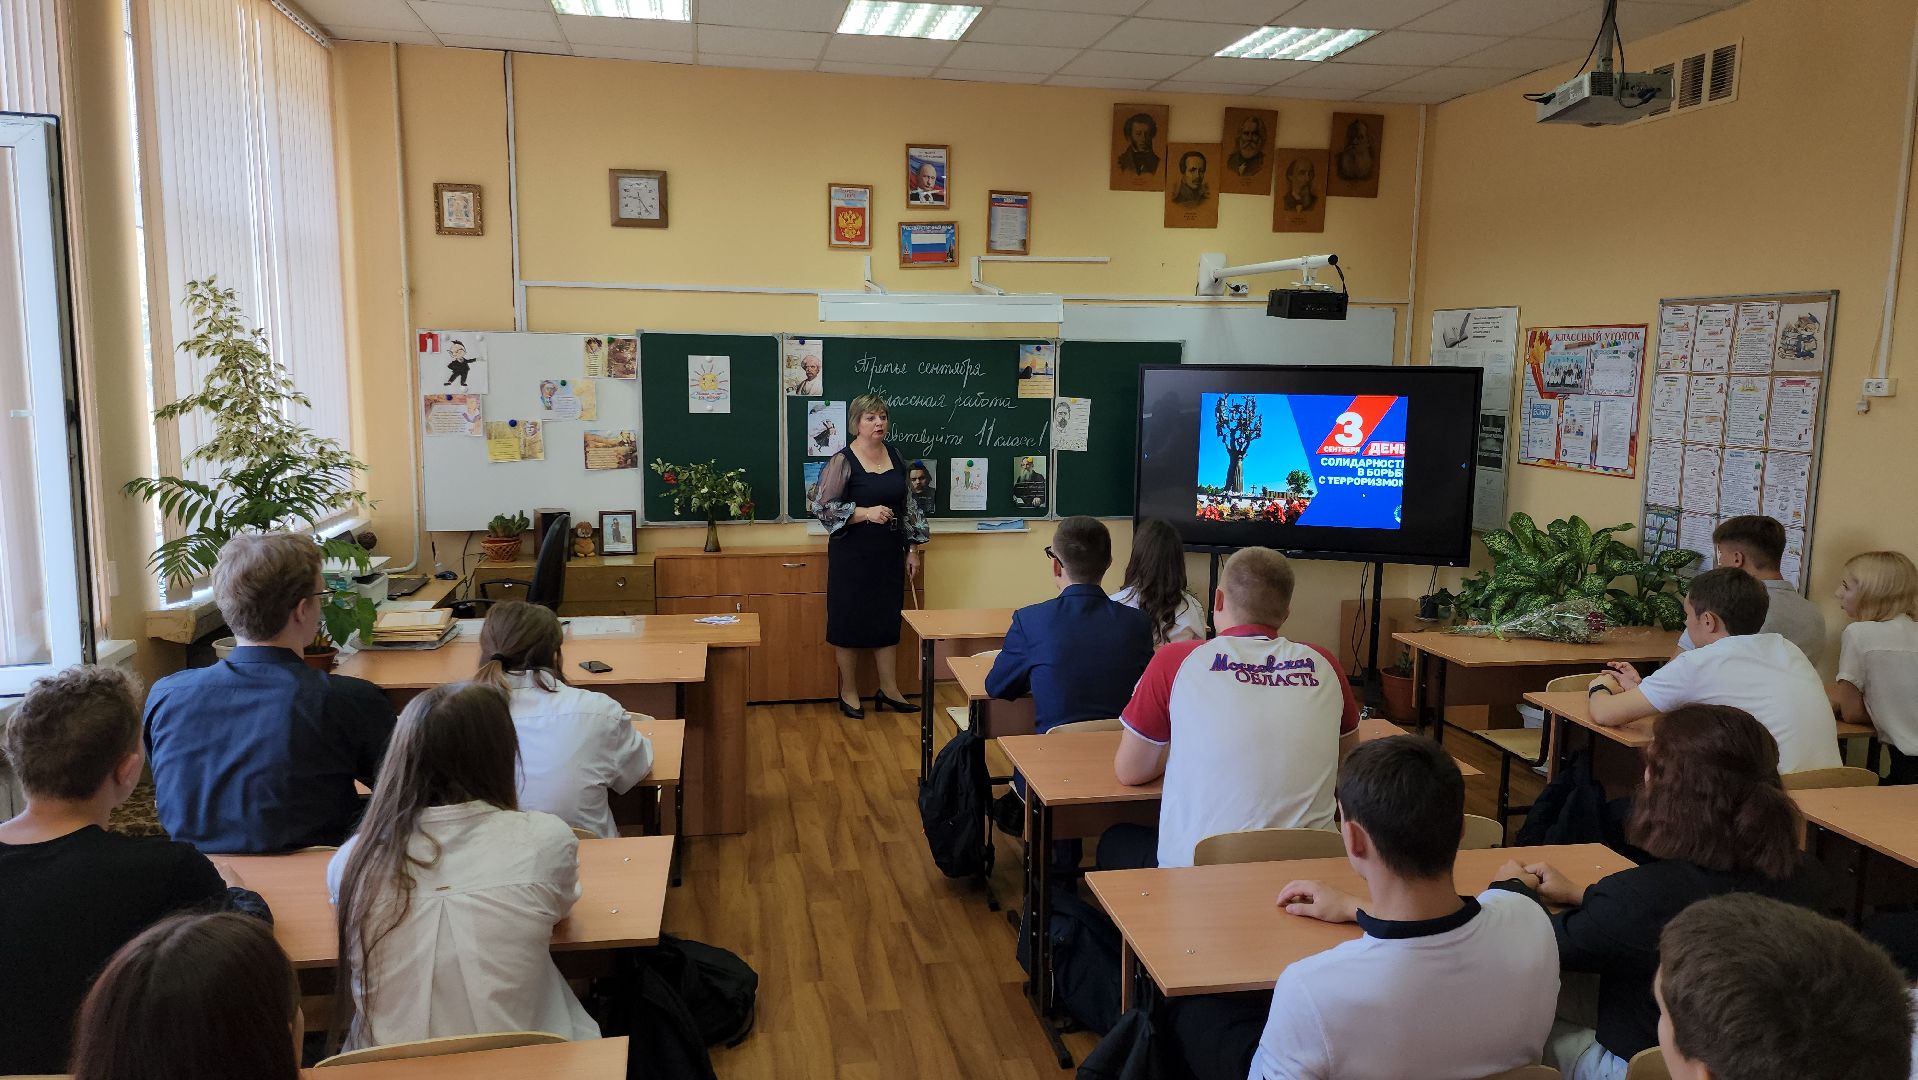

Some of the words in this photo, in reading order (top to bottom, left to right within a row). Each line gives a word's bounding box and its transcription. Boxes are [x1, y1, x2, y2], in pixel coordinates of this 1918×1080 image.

[1554, 331, 1602, 342] КЛАССНЫЙ
[1604, 331, 1641, 341] УГОЛОК
[854, 352, 907, 389] Третье
[918, 358, 987, 388] сентября
[948, 391, 1018, 423] работа
[974, 417, 997, 447] 11
[1335, 412, 1363, 446] 3
[1318, 475, 1325, 484] С
[1357, 468, 1365, 476] В
[1366, 468, 1404, 478] БОРЬБ
[1209, 653, 1315, 673] Московская
[1235, 670, 1319, 686] ОБЛАСТЬ
